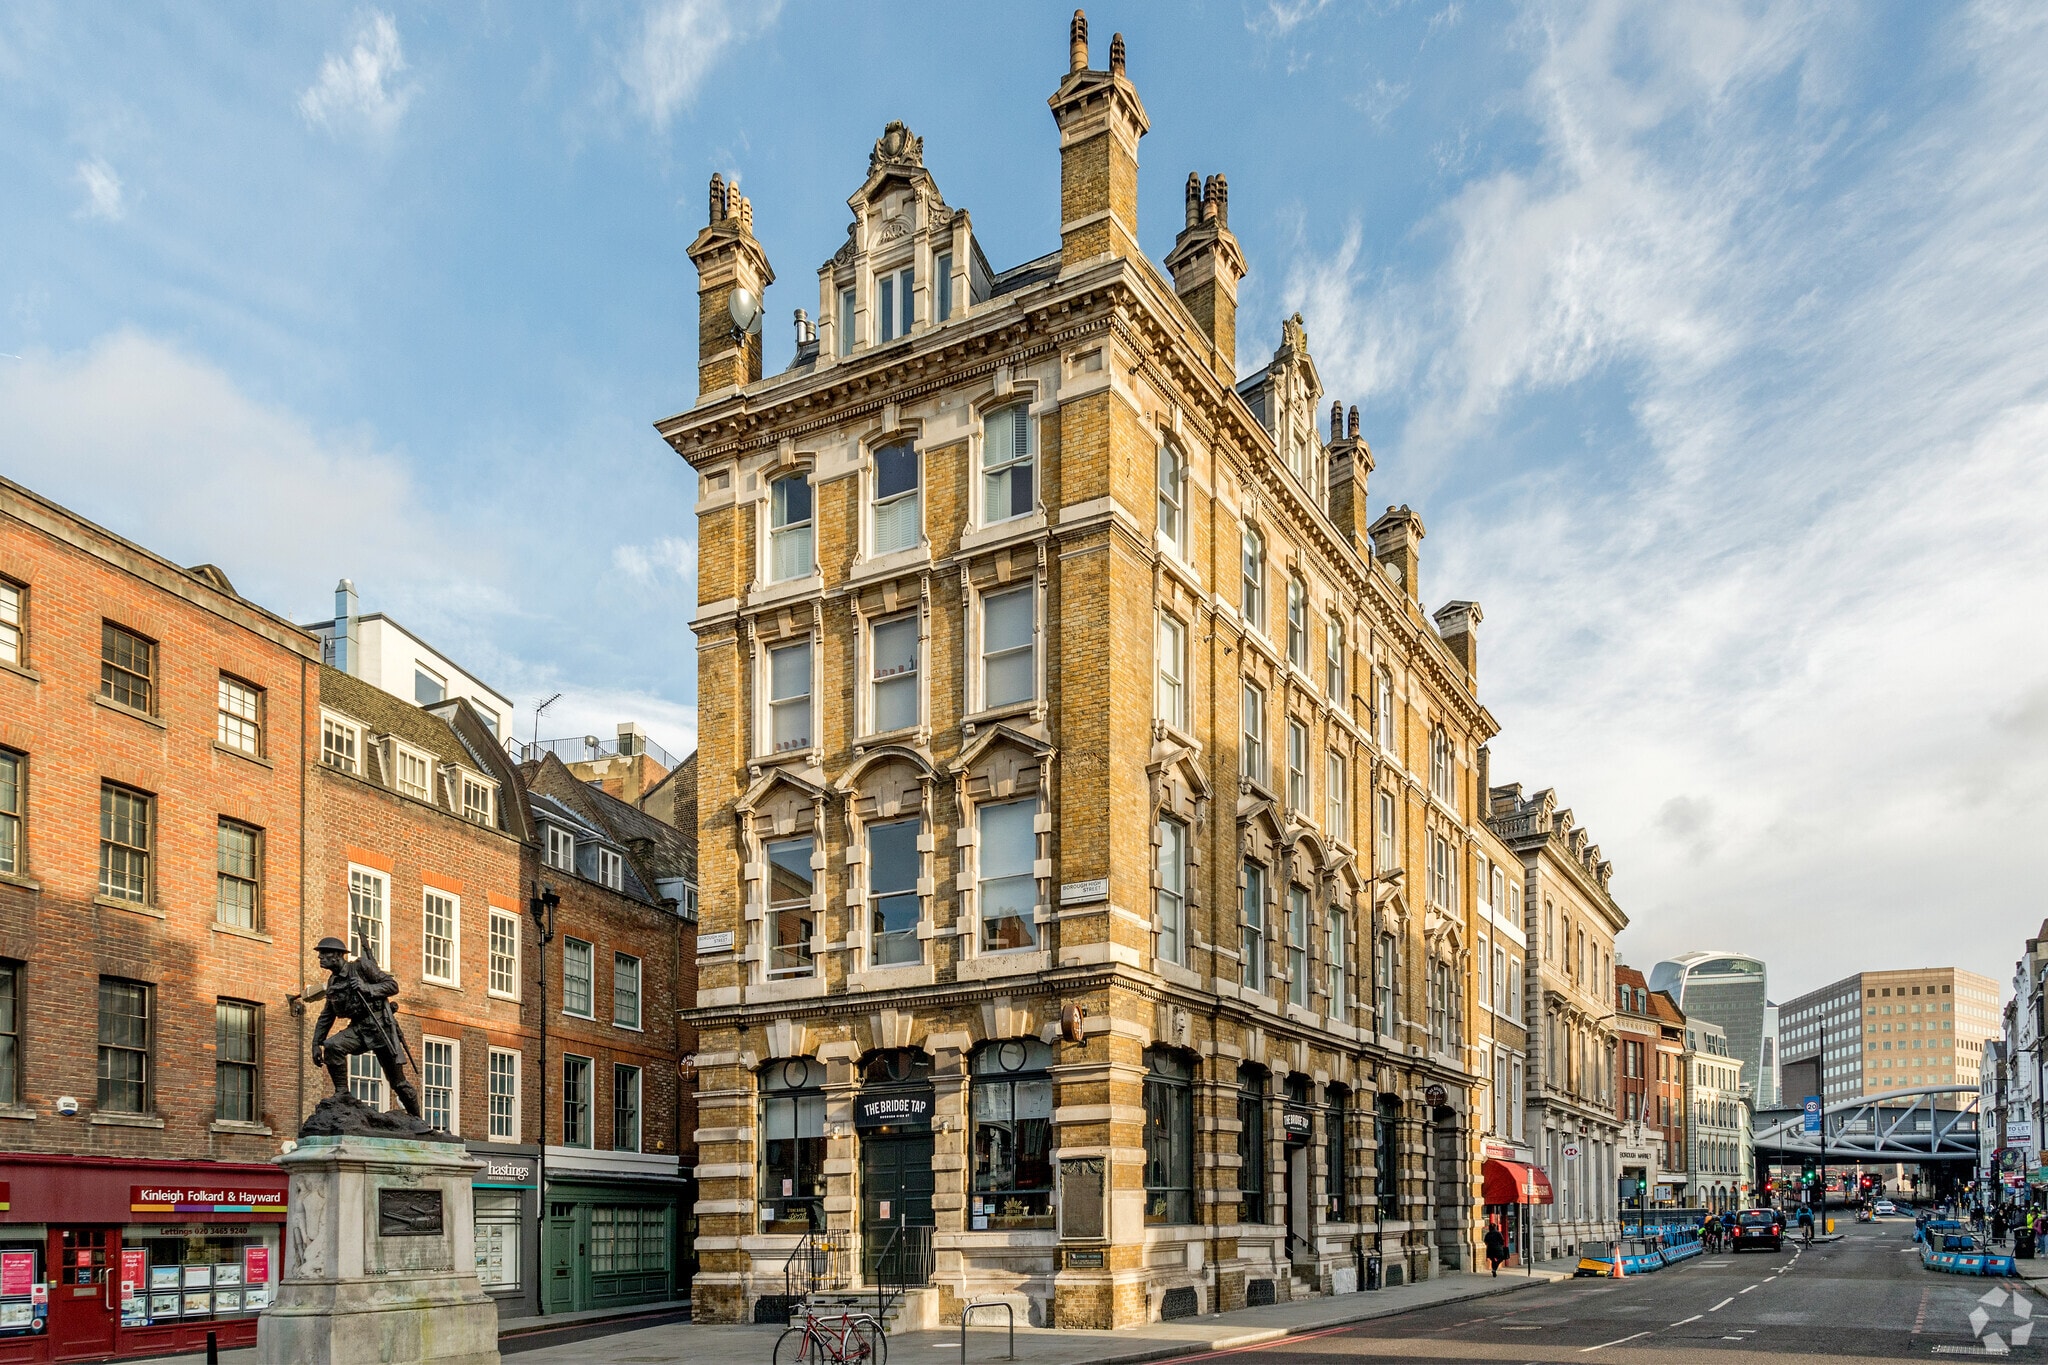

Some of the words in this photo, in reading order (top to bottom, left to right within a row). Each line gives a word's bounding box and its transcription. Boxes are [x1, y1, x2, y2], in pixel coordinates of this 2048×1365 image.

[1062, 883, 1088, 891] BOROUGH
[1082, 885, 1101, 893] STREET
[863, 1101, 880, 1117] THE
[880, 1099, 909, 1113] BRIDGE
[910, 1100, 926, 1113] TAP
[1283, 1114, 1291, 1126] THE
[1290, 1114, 1303, 1126] BRIDGE
[1619, 1151, 1636, 1159] BOROUGH
[487, 1160, 529, 1181] hastings
[141, 1189, 184, 1203] Kinleigh
[187, 1190, 224, 1202] Folkard
[227, 1191, 236, 1202] &
[239, 1191, 281, 1205] Hayward
[160, 1227, 193, 1237] Lettings
[194, 1227, 209, 1235] 020
[209, 1227, 228, 1235] 3465
[229, 1227, 248, 1235] 9240
